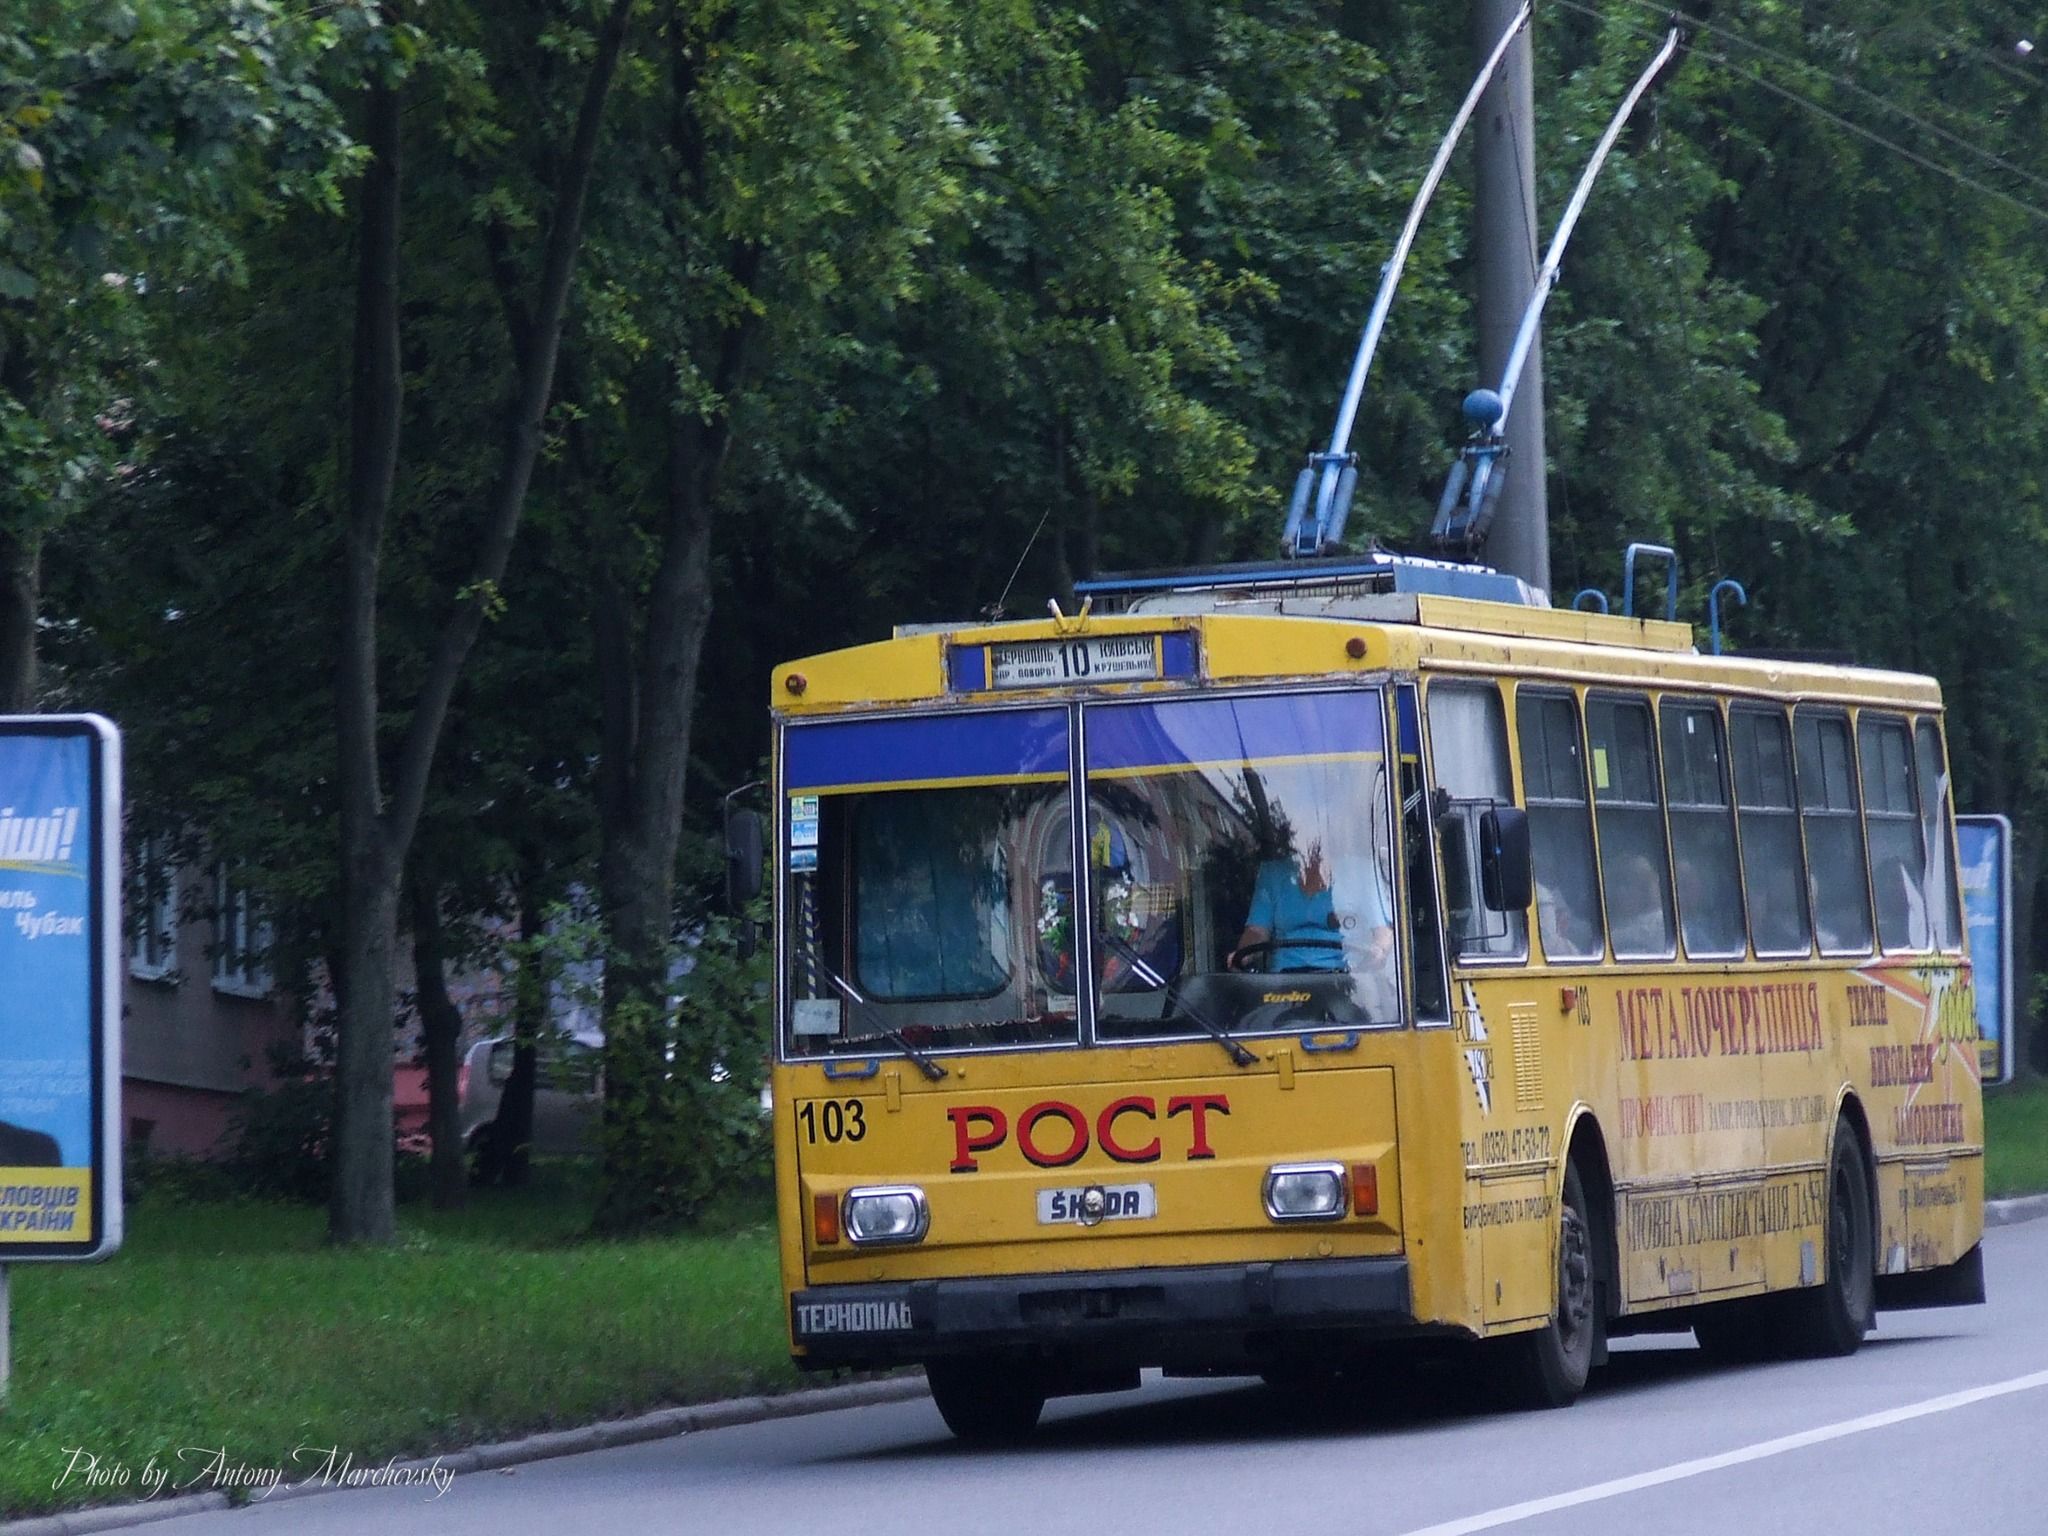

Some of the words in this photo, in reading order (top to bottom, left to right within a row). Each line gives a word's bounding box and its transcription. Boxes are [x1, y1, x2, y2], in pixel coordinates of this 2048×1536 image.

[1059, 642, 1090, 677] 10
[16, 910, 84, 940] Чубак
[1575, 985, 1591, 1026] 103
[1617, 984, 1822, 1061] МЕТАЛОЧЕРЕПИЦЯ
[799, 1100, 867, 1145] 103
[947, 1094, 1232, 1173] РОСТ
[1051, 1190, 1140, 1219] ŠKDA
[1631, 1200, 1683, 1251] ПОВНА
[1686, 1184, 1790, 1246] КОМПЛЕКТАЦІЯ
[797, 1301, 913, 1334] ТЕРНОПІЛЬ
